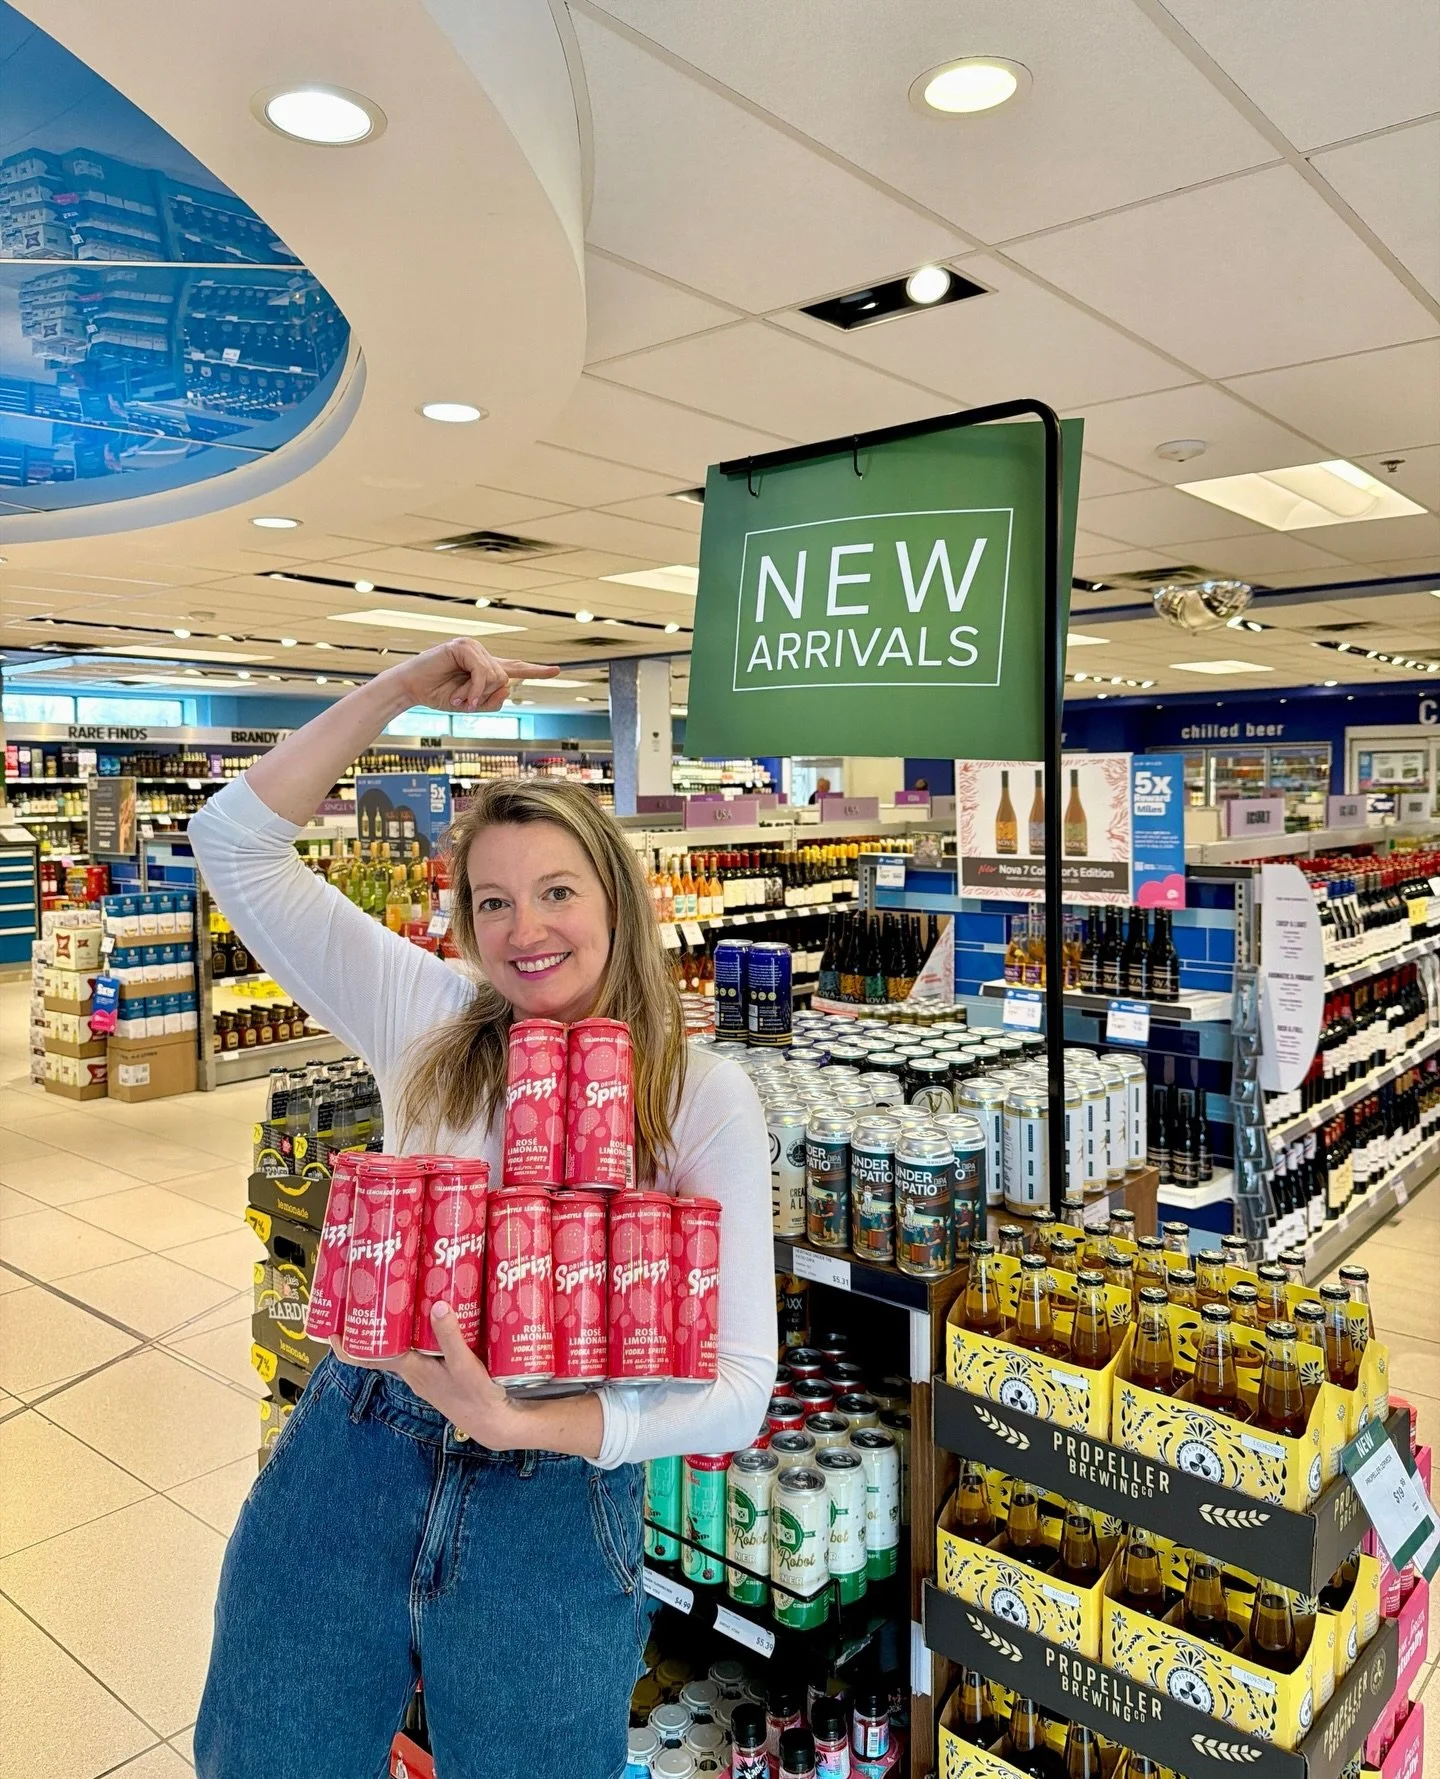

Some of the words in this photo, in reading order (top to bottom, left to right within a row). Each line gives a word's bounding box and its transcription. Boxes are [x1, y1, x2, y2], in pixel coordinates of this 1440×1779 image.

[755, 538, 988, 623] NEW
[746, 625, 979, 673] ARRIVALS
[68, 726, 106, 740] RARE
[107, 727, 148, 740] FINDS
[231, 731, 279, 743] BRANDY
[1181, 723, 1239, 739] chilled
[1245, 722, 1284, 738] beer
[420, 738, 442, 747] RUM
[1134, 771, 1173, 795] 5x
[430, 783, 446, 799] 5x
[715, 809, 733, 820] USA
[1136, 805, 1162, 813] Miles
[999, 865, 1022, 875] Nova
[1023, 866, 1028, 875] 7
[1080, 868, 1115, 879] Edition
[516, 1137, 538, 1147] ROSÉ
[508, 1145, 548, 1155] LIMONATA
[852, 1153, 889, 1171] UNDER
[860, 1169, 893, 1183] PATIO
[934, 1177, 947, 1185] DIPA
[902, 1181, 937, 1196] PATIO
[277, 1198, 309, 1219] lemonade
[613, 1252, 669, 1294] Sprizzi
[832, 1275, 849, 1286] $5.31
[352, 1307, 376, 1317] ROSÉ
[524, 1322, 546, 1333] ROSÉ
[635, 1327, 658, 1336] ROSÉ
[624, 1336, 667, 1345] LIMONATA
[280, 1338, 310, 1364] lemonade
[513, 1345, 534, 1353] VODKA
[625, 1348, 645, 1356] VODKA
[255, 1352, 270, 1373] 7%
[1355, 1430, 1375, 1459] NEW
[1052, 1430, 1171, 1495] PROPELLER
[1069, 1457, 1139, 1500] BREWING
[1392, 1486, 1405, 1504] $19
[734, 1527, 768, 1549] Robot
[778, 1547, 815, 1571] Robot
[675, 1596, 691, 1610] $4.99
[756, 1637, 774, 1651] $5.39
[1045, 1647, 1163, 1721] PROPELLER
[1061, 1675, 1132, 1722] BREWING
[1323, 1669, 1368, 1755] PROPELLER
